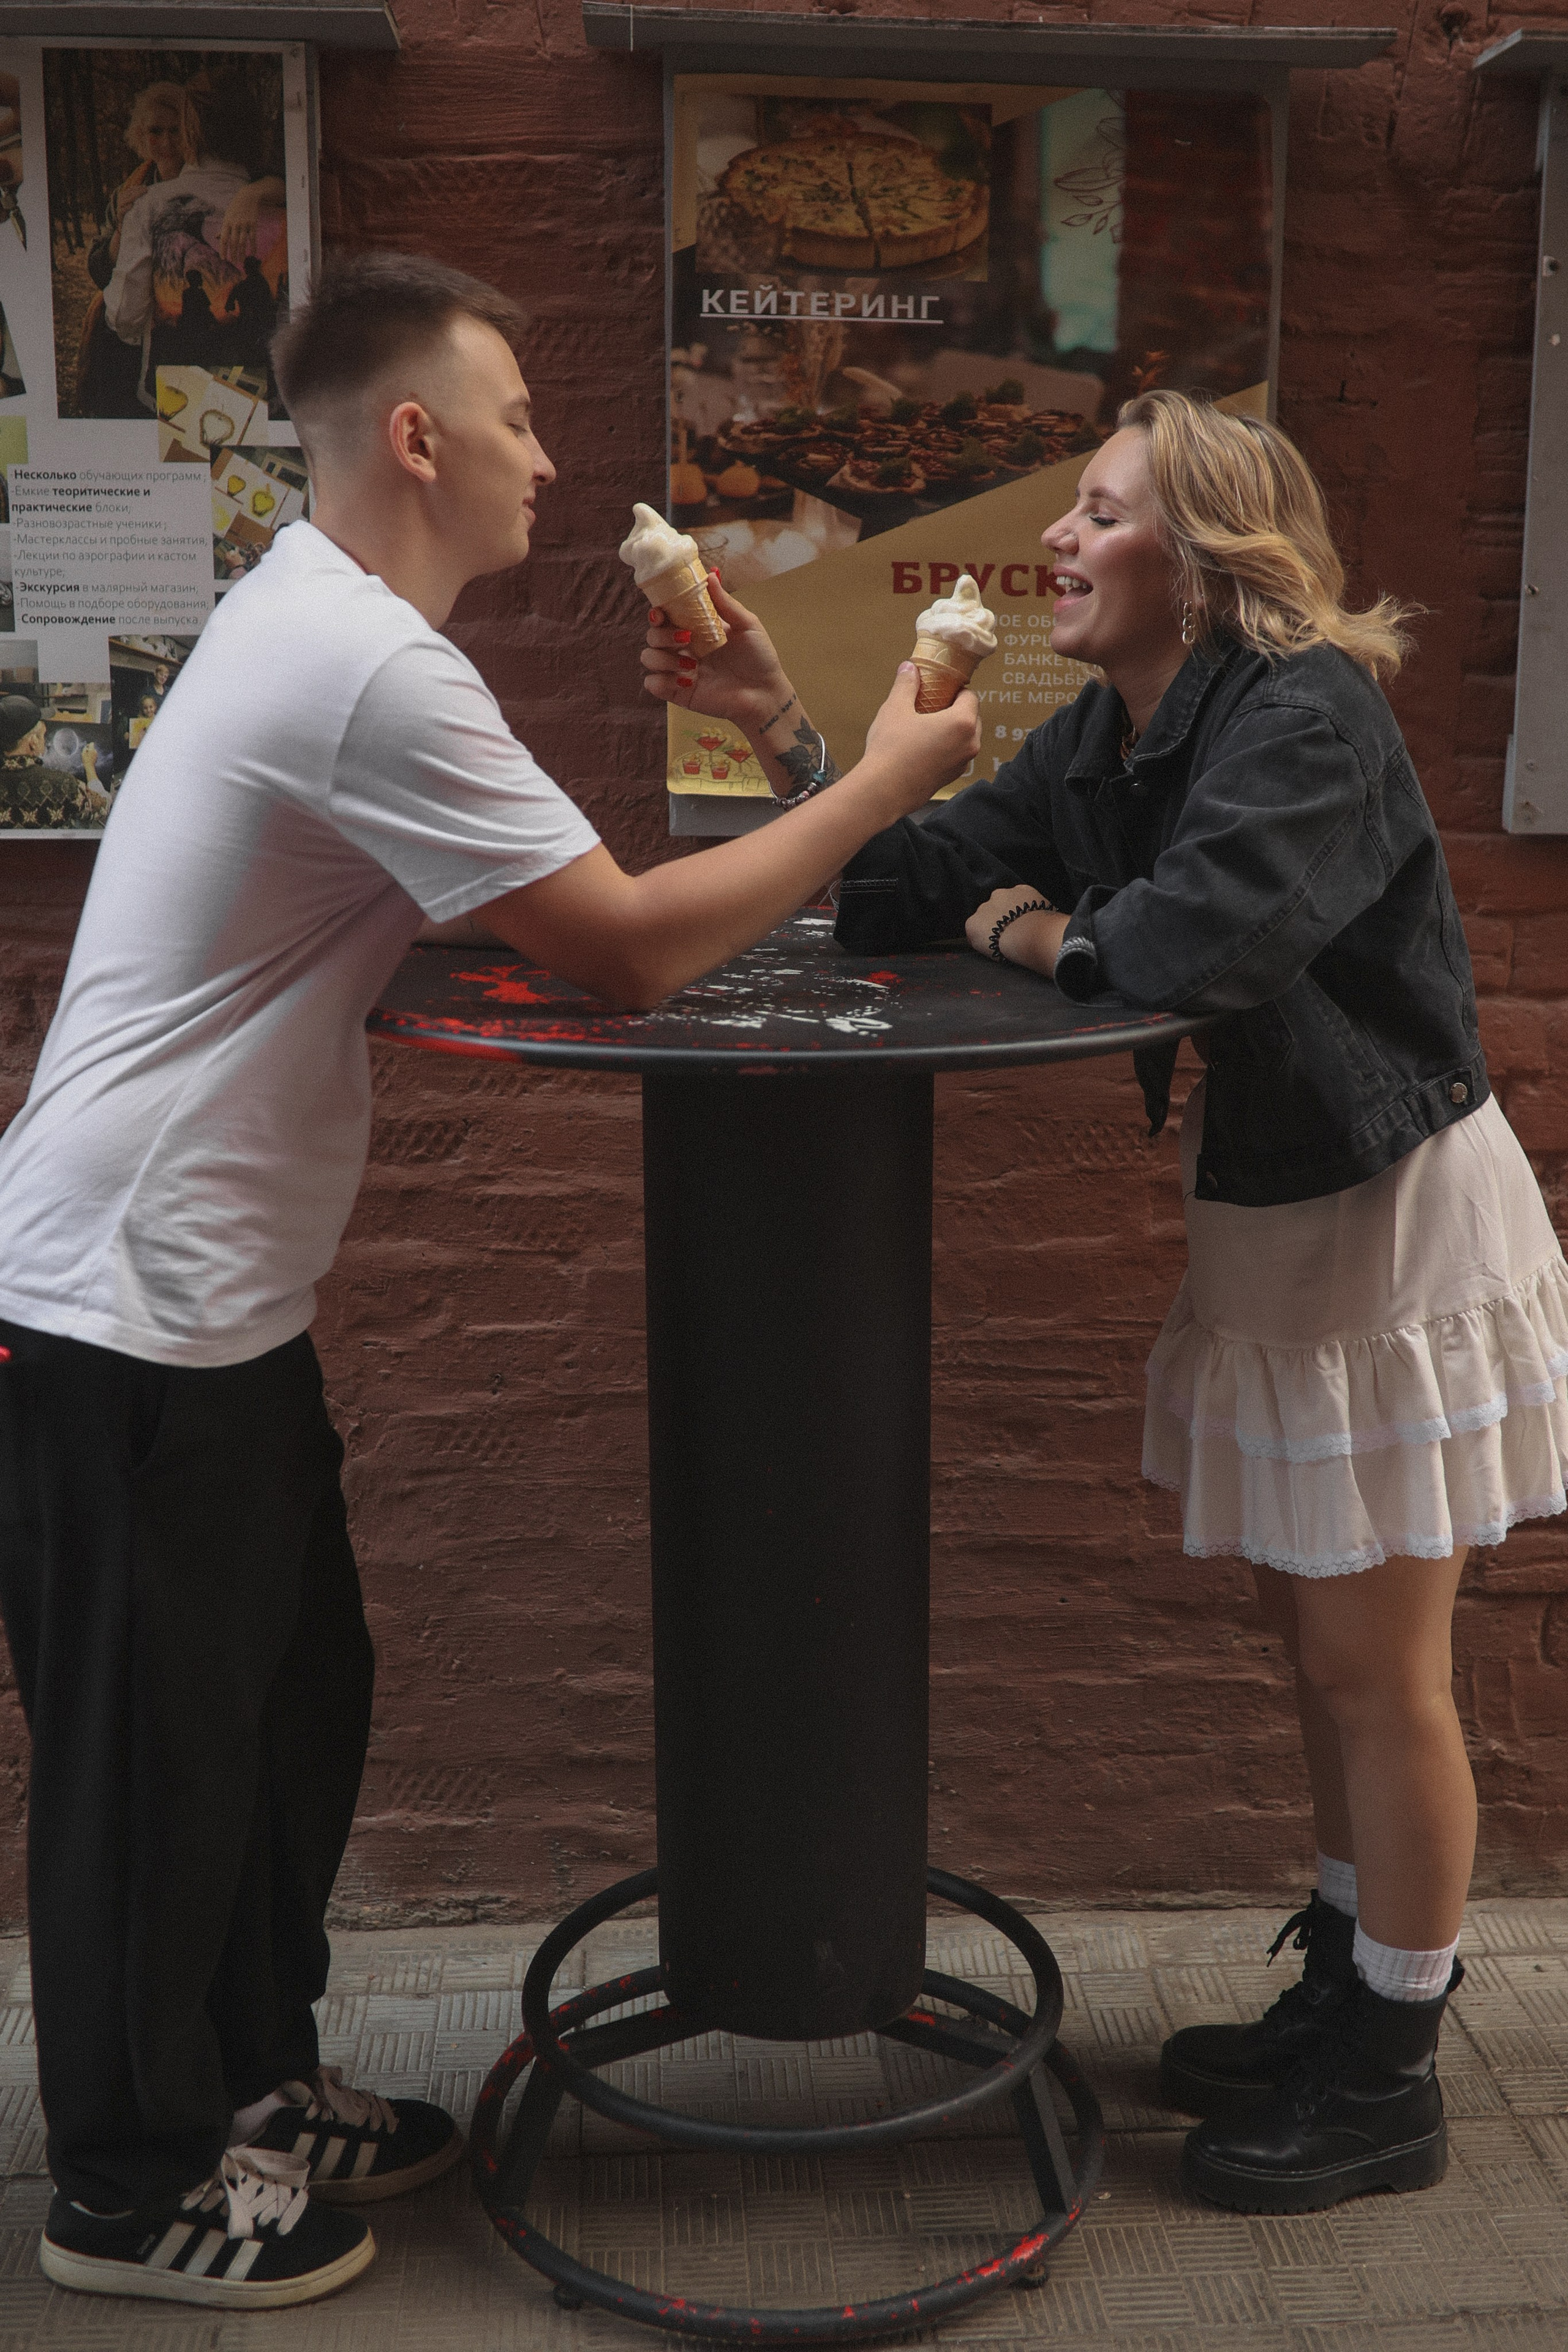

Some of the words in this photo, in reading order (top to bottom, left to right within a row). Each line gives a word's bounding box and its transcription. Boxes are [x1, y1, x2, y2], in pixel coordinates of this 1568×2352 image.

[701, 284, 940, 319] КЕЙТЕРИНГ
[80, 470, 143, 483] обучающих
[53, 488, 140, 498] теоритические
[12, 503, 92, 514] практические
[110, 535, 157, 546] пробные
[78, 551, 145, 563] аэрографии
[91, 582, 148, 595] малярный
[78, 598, 124, 609] подборе
[995, 725, 1007, 739] 8
